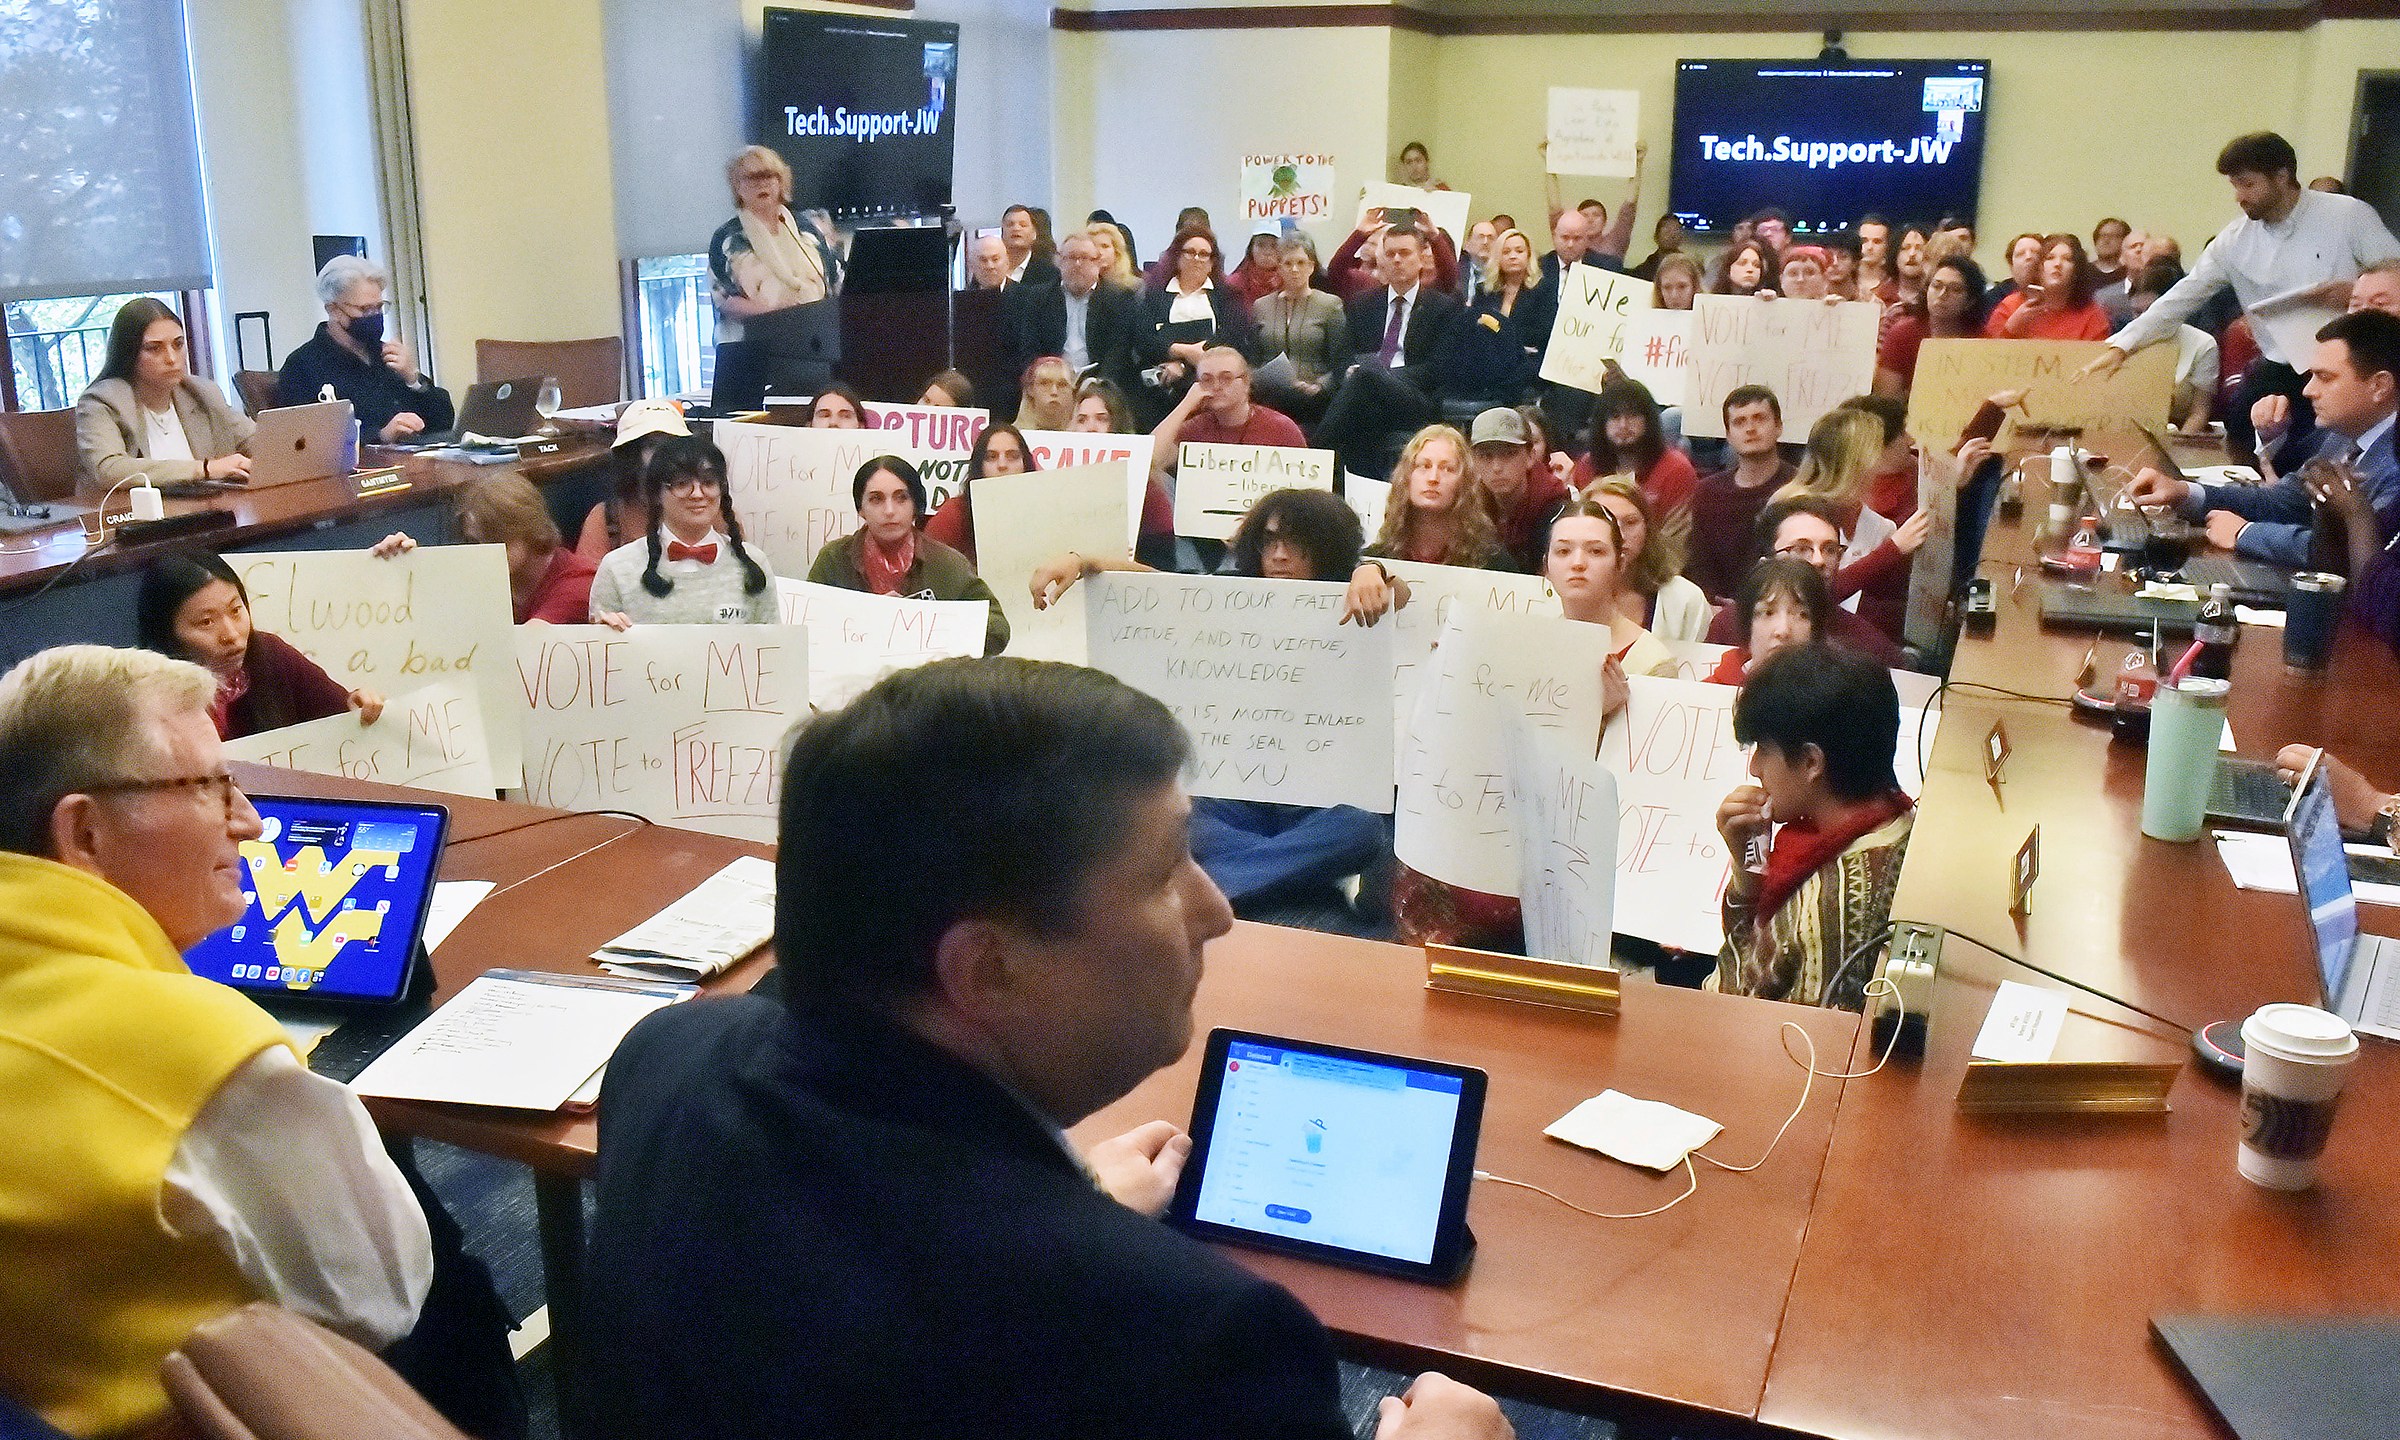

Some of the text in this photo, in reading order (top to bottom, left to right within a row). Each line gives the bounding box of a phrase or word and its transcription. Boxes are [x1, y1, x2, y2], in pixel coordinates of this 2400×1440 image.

[784, 105, 940, 143] Tech.Support-JW
[1245, 154, 1335, 167] POWER TO THE
[1699, 134, 1954, 168] Tech.Support-JW
[1248, 194, 1327, 218] PUPPETS!
[1583, 273, 1630, 317] We
[538, 443, 559, 453] TACK
[1182, 445, 1321, 480] Liberal Arts
[789, 454, 817, 482] for
[918, 459, 971, 482] NOT
[106, 511, 135, 524] CRAIG
[243, 561, 414, 634] Elwood
[1100, 582, 1346, 615] ADD TO YOUR FAIT
[842, 616, 868, 643] for
[888, 608, 958, 652] ME
[1109, 625, 1348, 659] VIRTUE, AND TO VIRTUE,
[347, 639, 479, 674] a bad
[1165, 657, 1306, 683] KNOWLEDGE
[515, 640, 783, 711] VOTE for ME
[1231, 706, 1295, 723] MOTTO
[336, 738, 381, 781] for
[407, 698, 467, 769] ME
[1200, 731, 1335, 753] THE SEAL OF
[1624, 699, 1734, 781] VOTE
[521, 720, 780, 811] VOTE to FREEZE
[1433, 769, 1464, 810] to
[1687, 832, 1717, 860] to
